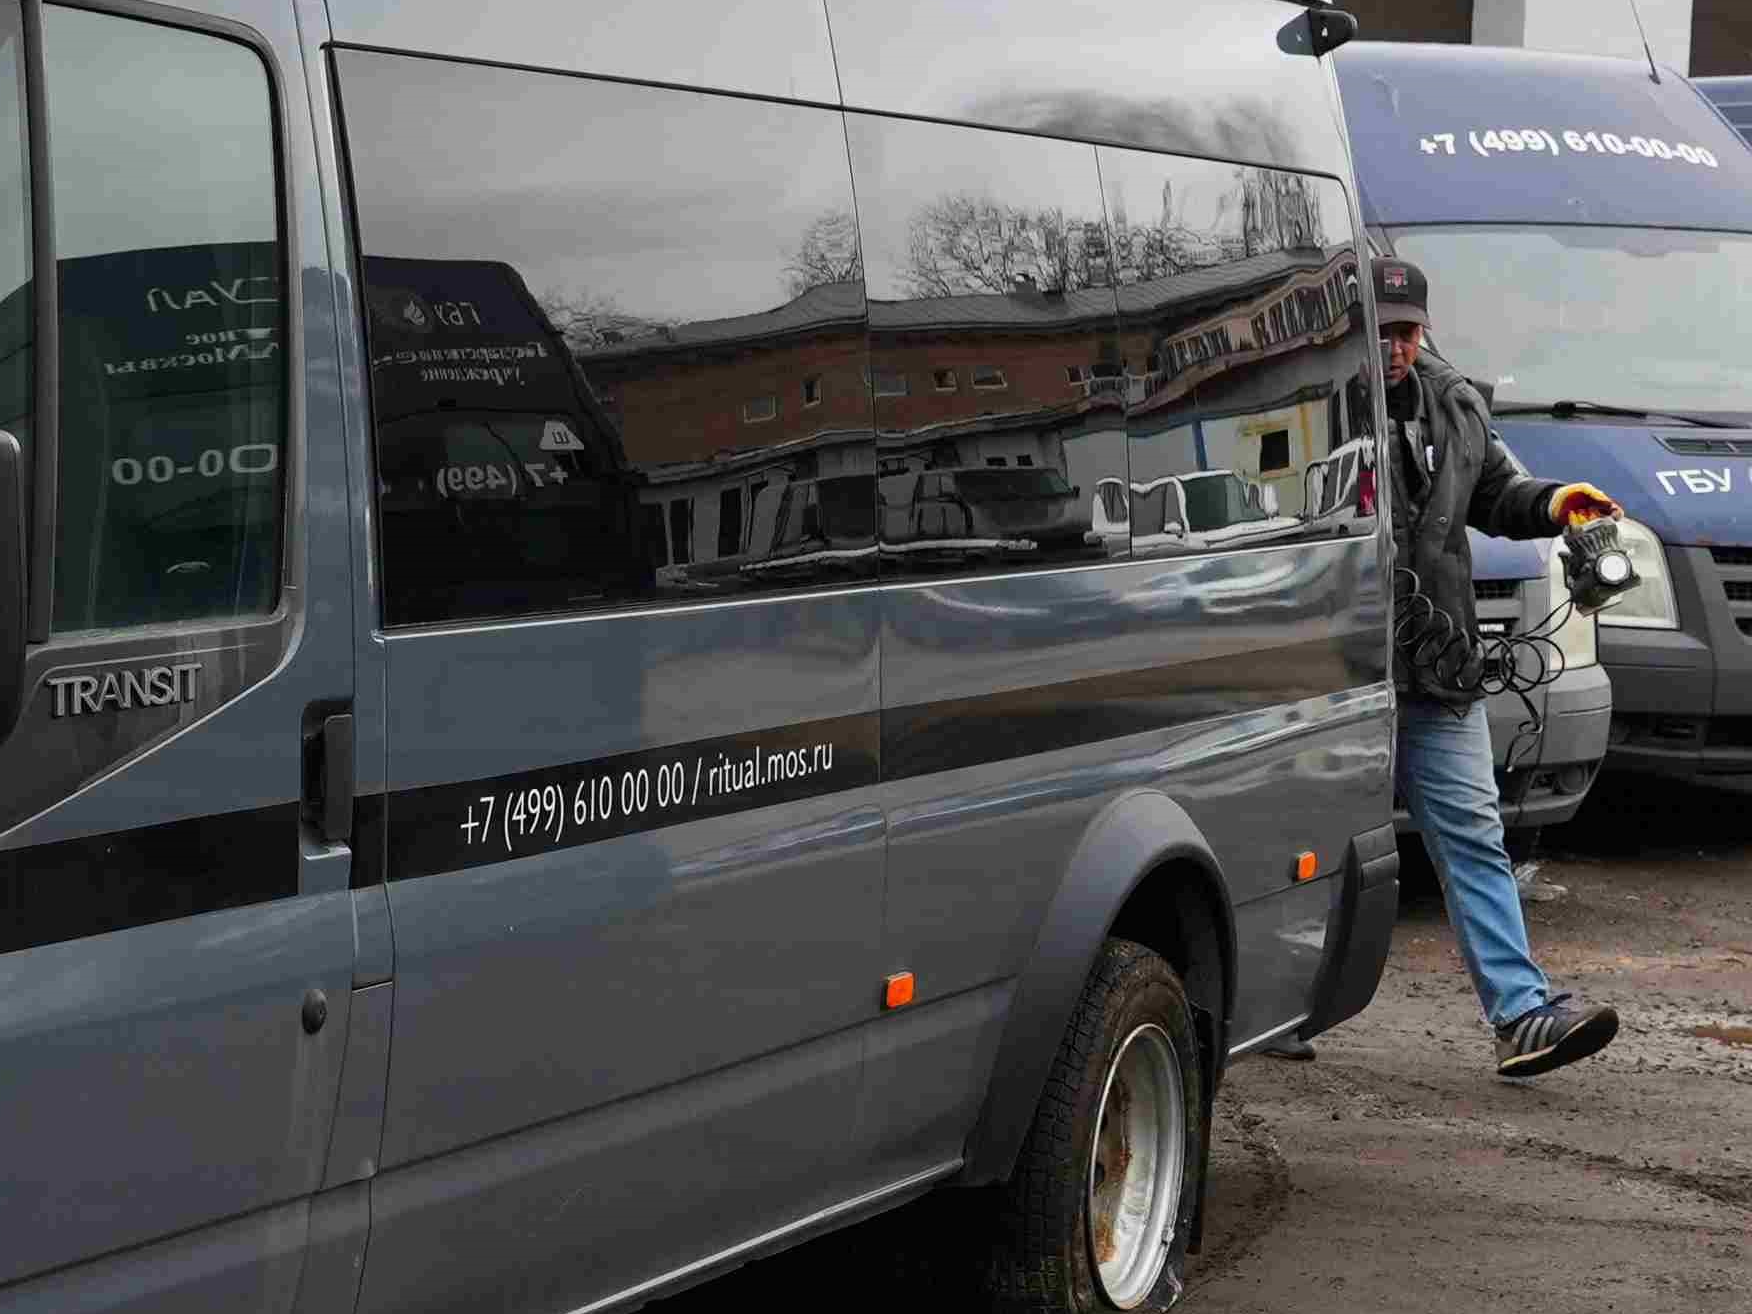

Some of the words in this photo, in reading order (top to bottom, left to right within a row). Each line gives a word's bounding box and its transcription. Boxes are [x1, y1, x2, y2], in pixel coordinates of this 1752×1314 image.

[1419, 132, 1457, 156] +7
[1468, 129, 1561, 158] (499)
[1562, 129, 1719, 168] 610-00-00
[1655, 467, 1733, 496] ГБУ
[46, 662, 202, 719] TRANSIT
[460, 795, 496, 844] +7
[503, 784, 565, 852] (499)
[573, 775, 613, 826] 610
[620, 767, 650, 816] 00
[656, 761, 685, 808] 00
[691, 756, 703, 806] /
[708, 741, 834, 797] ritual.mos.ru
